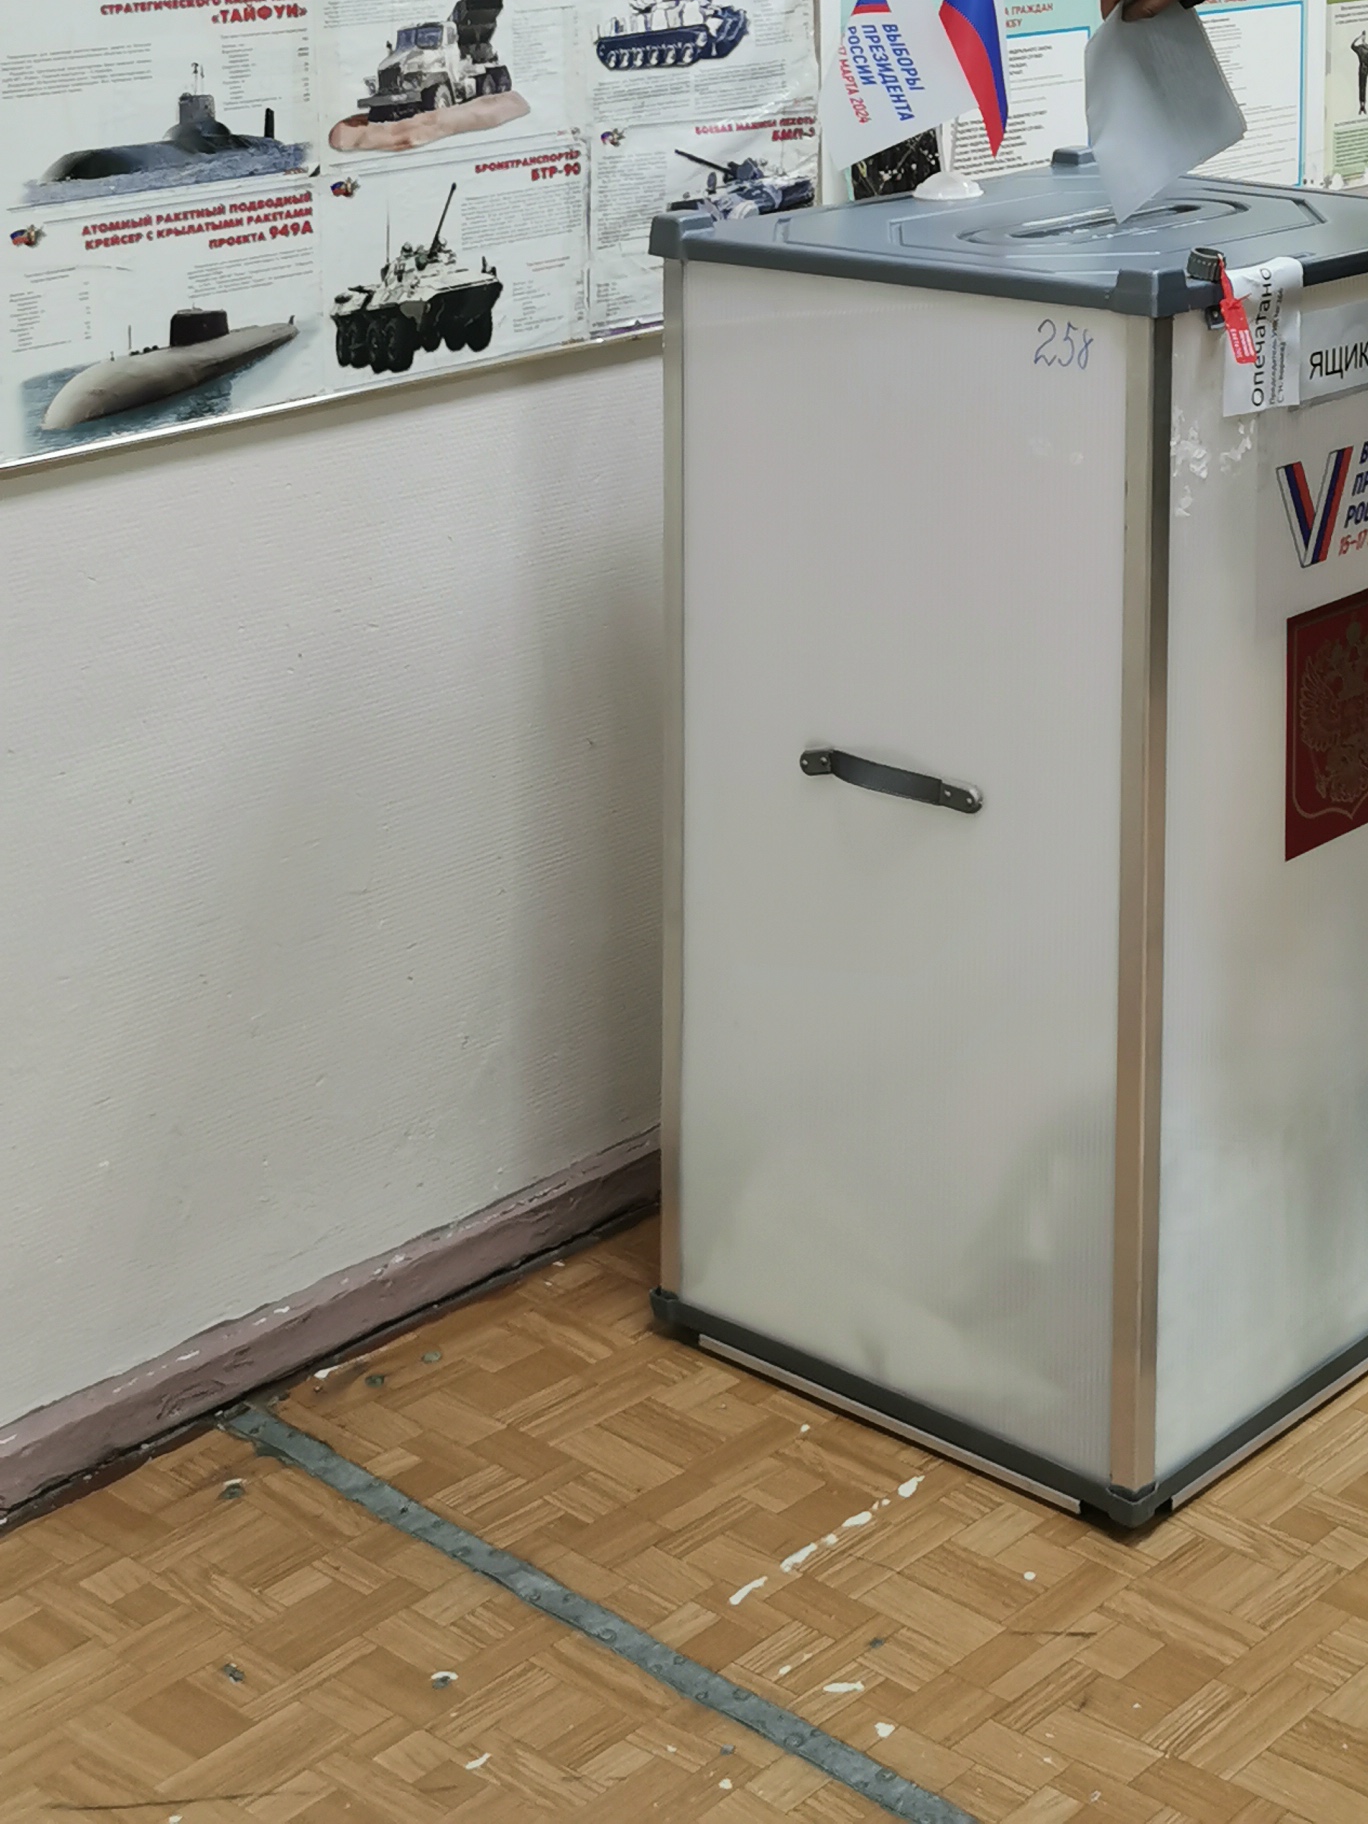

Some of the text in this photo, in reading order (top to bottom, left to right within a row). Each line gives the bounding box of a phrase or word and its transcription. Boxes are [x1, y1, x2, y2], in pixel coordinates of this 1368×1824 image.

[211, 4, 308, 24] «ТАЙФУН»
[1012, 3, 1053, 15] ГРАЖДАН
[848, 26, 877, 85] РОССИИ
[861, 25, 915, 121] ПРЕЗИДЕНТА
[882, 24, 925, 90] ВЫБОРЫ
[839, 59, 859, 95] МАРТА
[850, 98, 872, 123] 2024
[531, 162, 581, 182] БТР-90
[82, 192, 312, 237] АТОМНЫЙ РАКЕТНЫЙ ПОДВОДНЫЙ
[85, 207, 313, 250] КРЕЙСЕР С КРЫЛАТЫМИ РАКЕТАМИ
[208, 220, 314, 249] ПРОЕКТА 949А
[1033, 318, 1094, 370] 258
[1252, 268, 1272, 407] Опечатано
